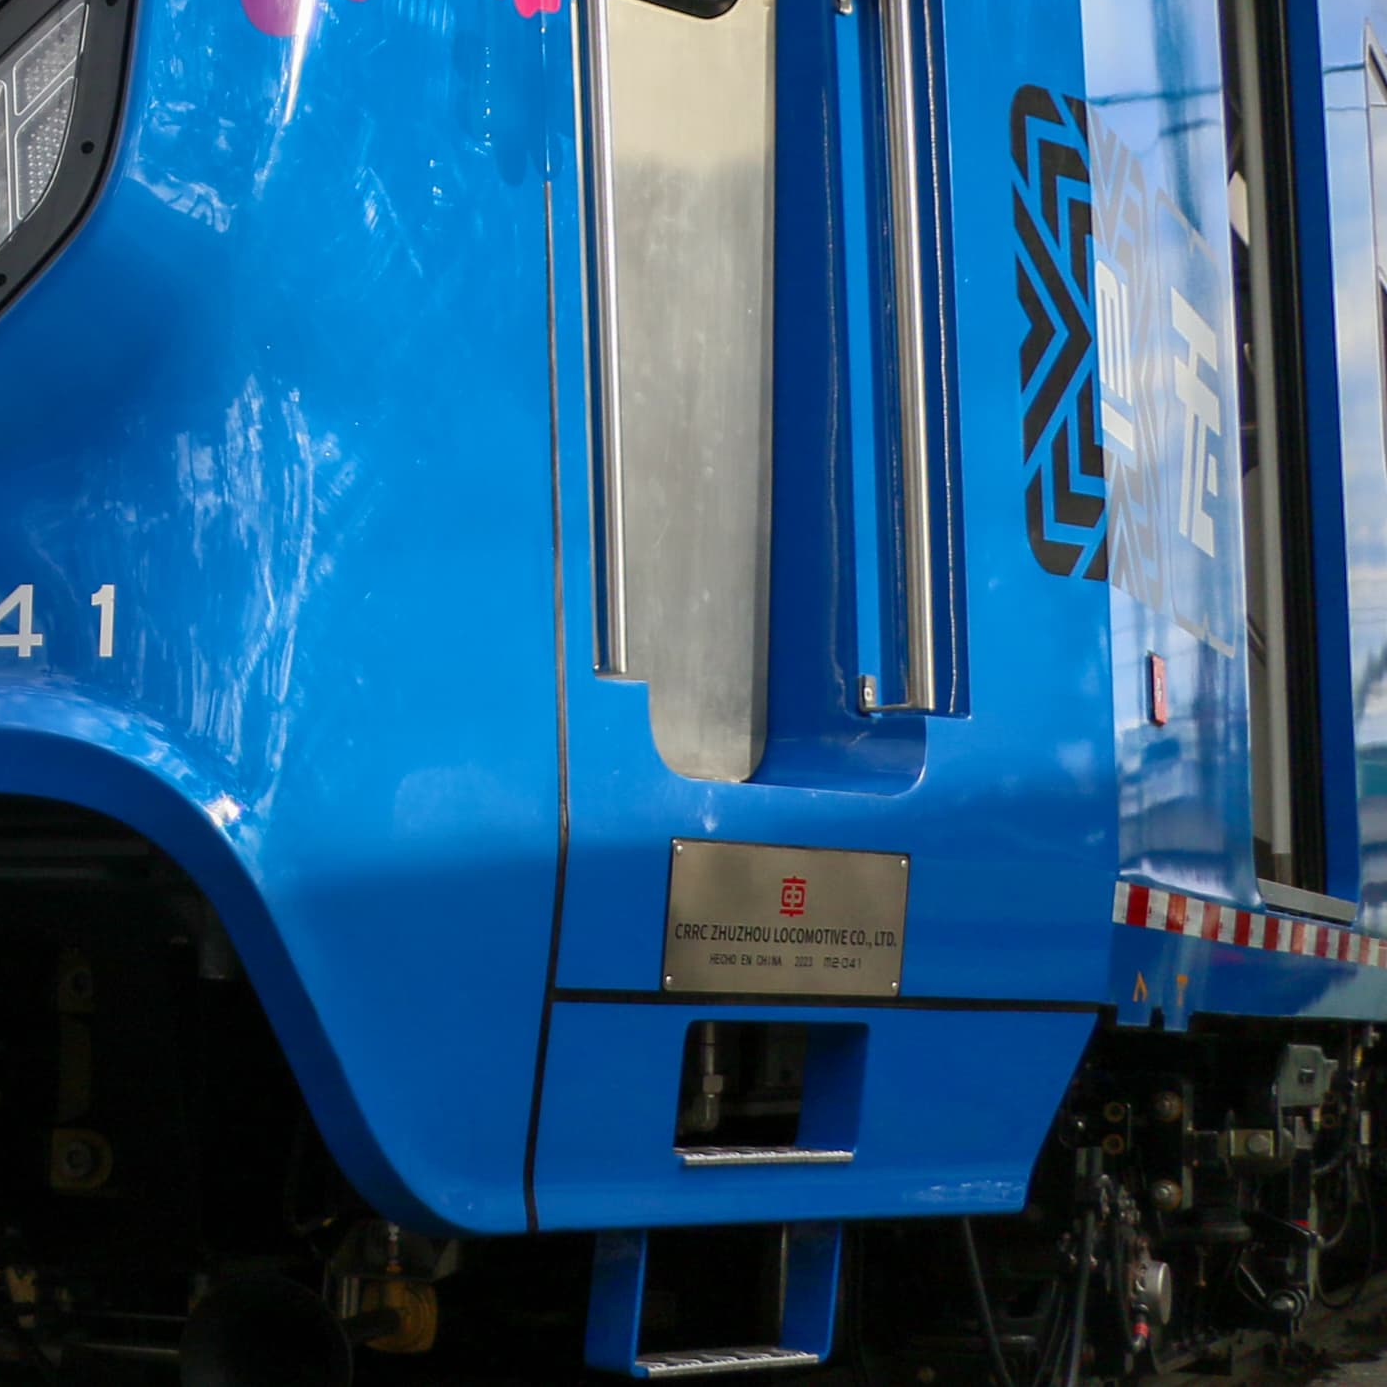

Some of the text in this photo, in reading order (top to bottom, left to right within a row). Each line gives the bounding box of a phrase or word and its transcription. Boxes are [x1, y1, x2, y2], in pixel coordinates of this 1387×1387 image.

[674, 922, 897, 949] CRRC ZHUZHOU LOCOMOTIVE CO., LTD.
[709, 953, 737, 966] HECHO
[741, 954, 752, 966] EN
[756, 954, 782, 967] CHINA
